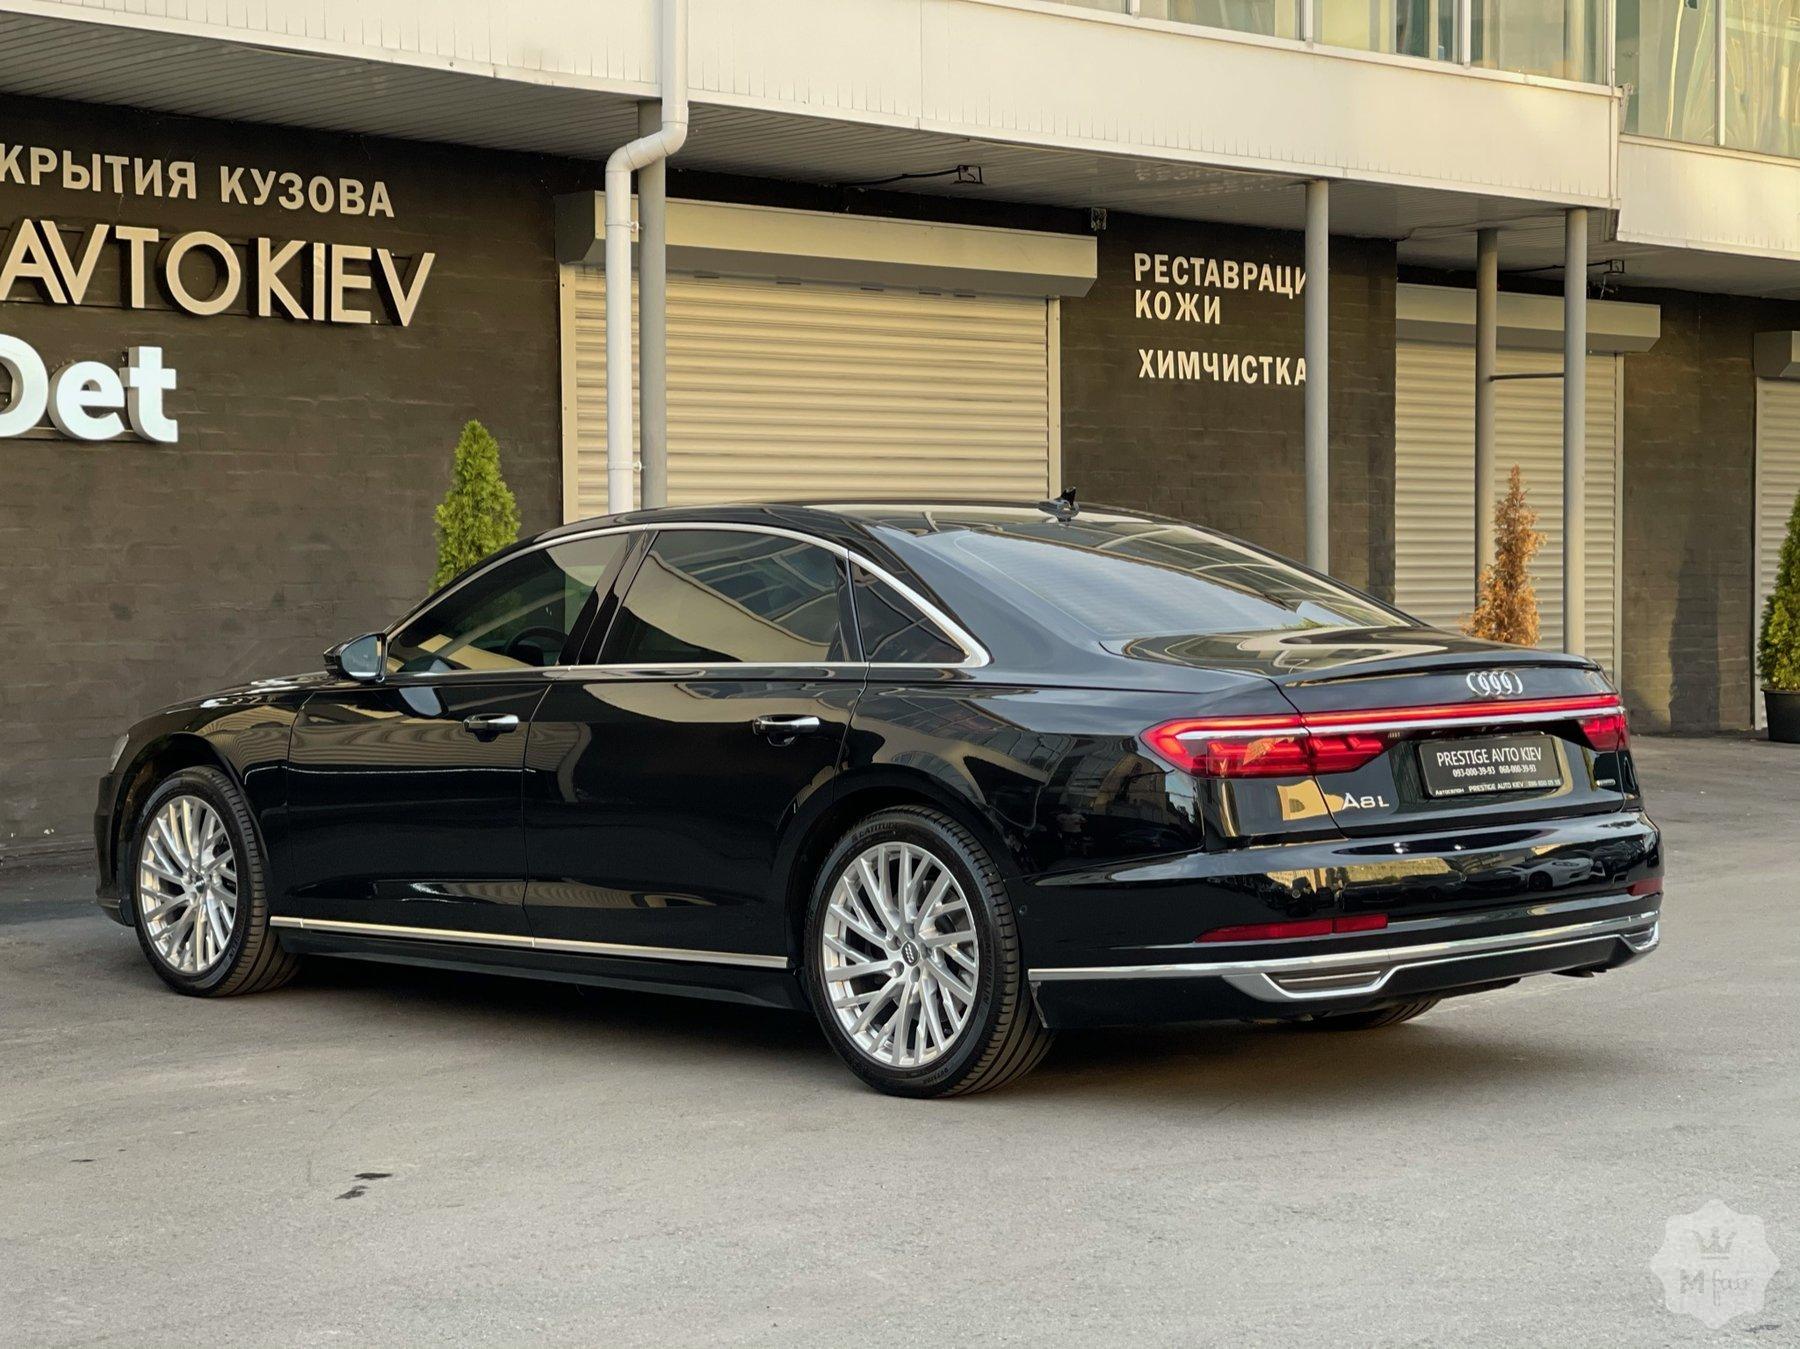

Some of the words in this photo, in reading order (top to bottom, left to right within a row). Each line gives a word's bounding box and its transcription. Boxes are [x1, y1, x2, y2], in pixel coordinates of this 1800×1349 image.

[0, 143, 197, 199] КРЫТИЯ
[219, 165, 395, 218] КУЗОВА
[1135, 289, 1221, 325] КОЖИ
[1138, 348, 1306, 386] ХИМЧИСТКА
[1437, 749, 1490, 766] PRESTIGE
[1492, 747, 1519, 763] AVTO
[1521, 747, 1542, 761] KIEV
[1453, 766, 1496, 778] 093-000-39-93
[1468, 783, 1496, 793] PRESTIGE
